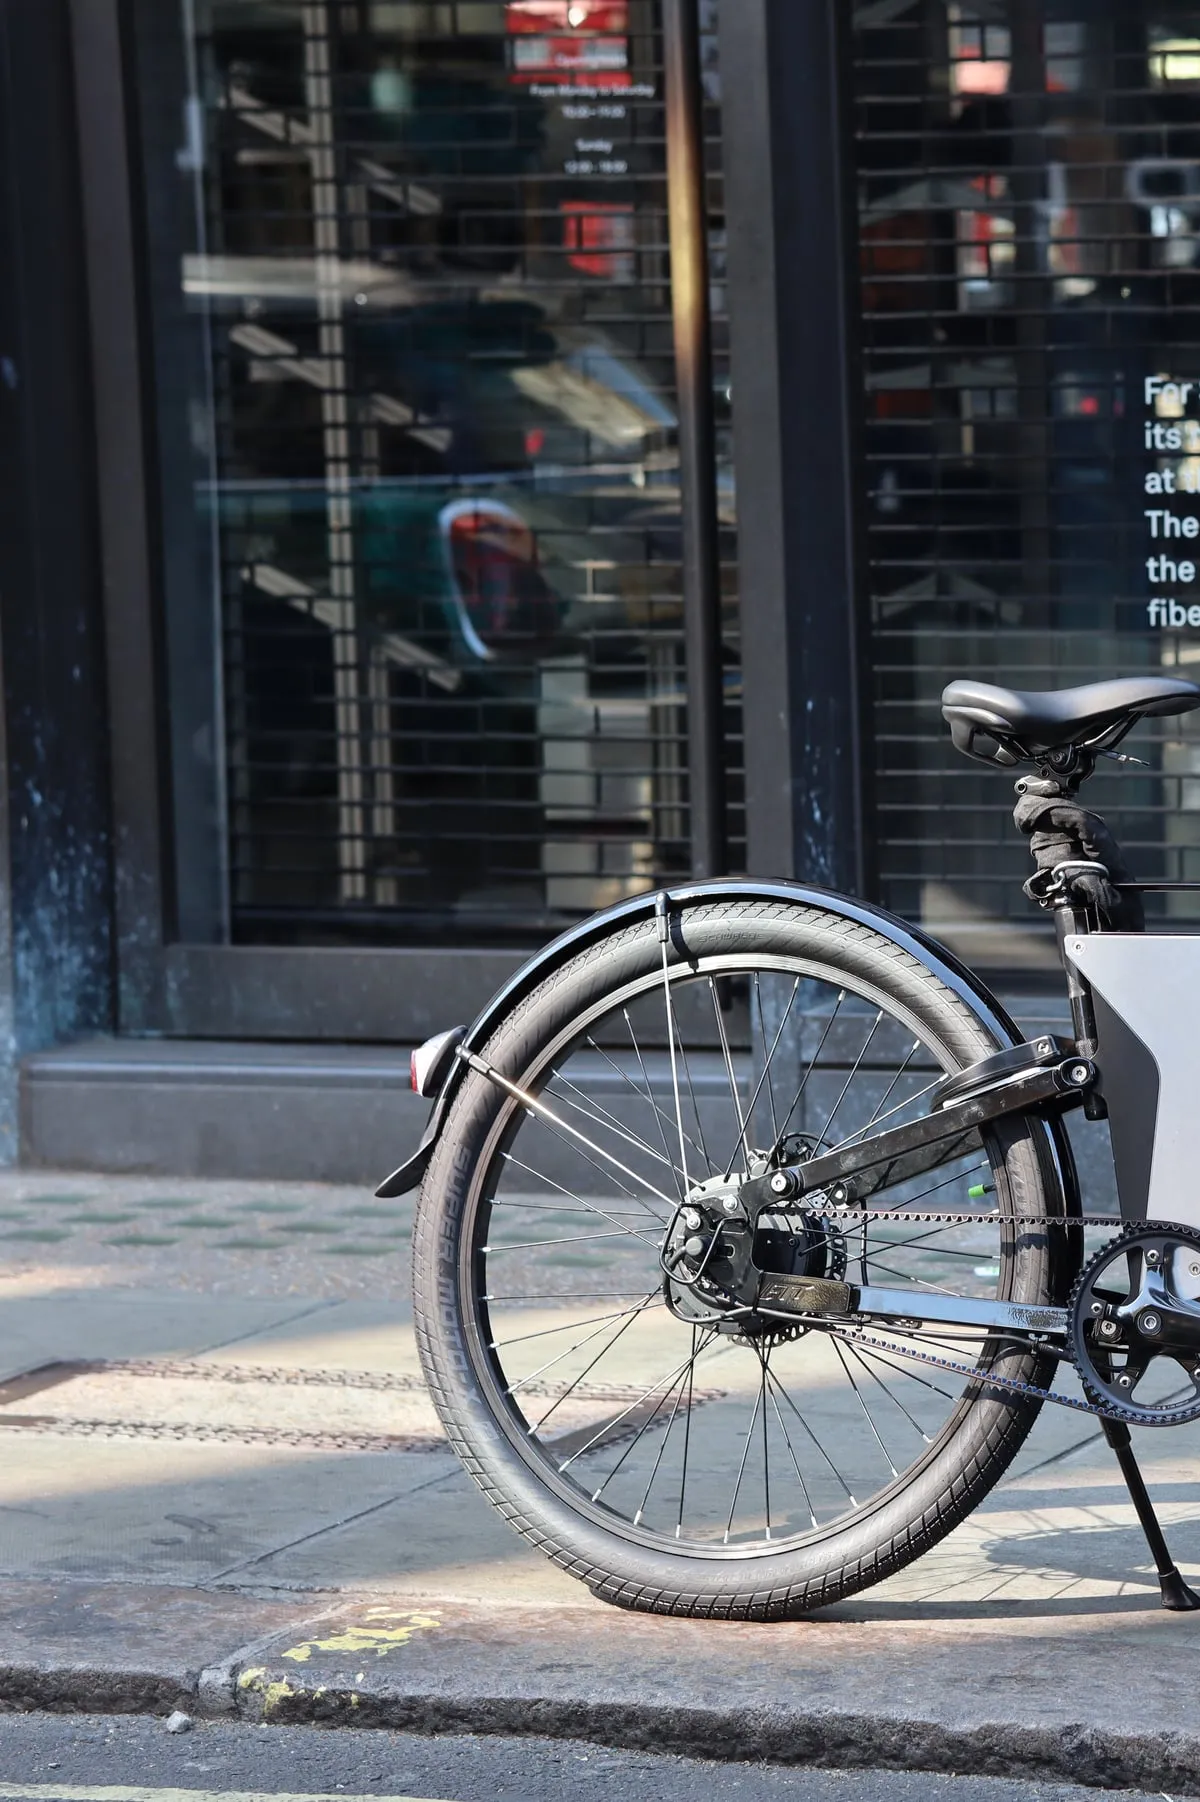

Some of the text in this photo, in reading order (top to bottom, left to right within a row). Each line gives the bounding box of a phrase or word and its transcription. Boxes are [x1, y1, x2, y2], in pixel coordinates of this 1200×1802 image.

[1144, 376, 1193, 405] For
[1145, 421, 1182, 449] its
[1145, 468, 1174, 494] at
[1144, 509, 1199, 538] The
[1146, 554, 1195, 583] the
[440, 1144, 471, 1264] SUPER
